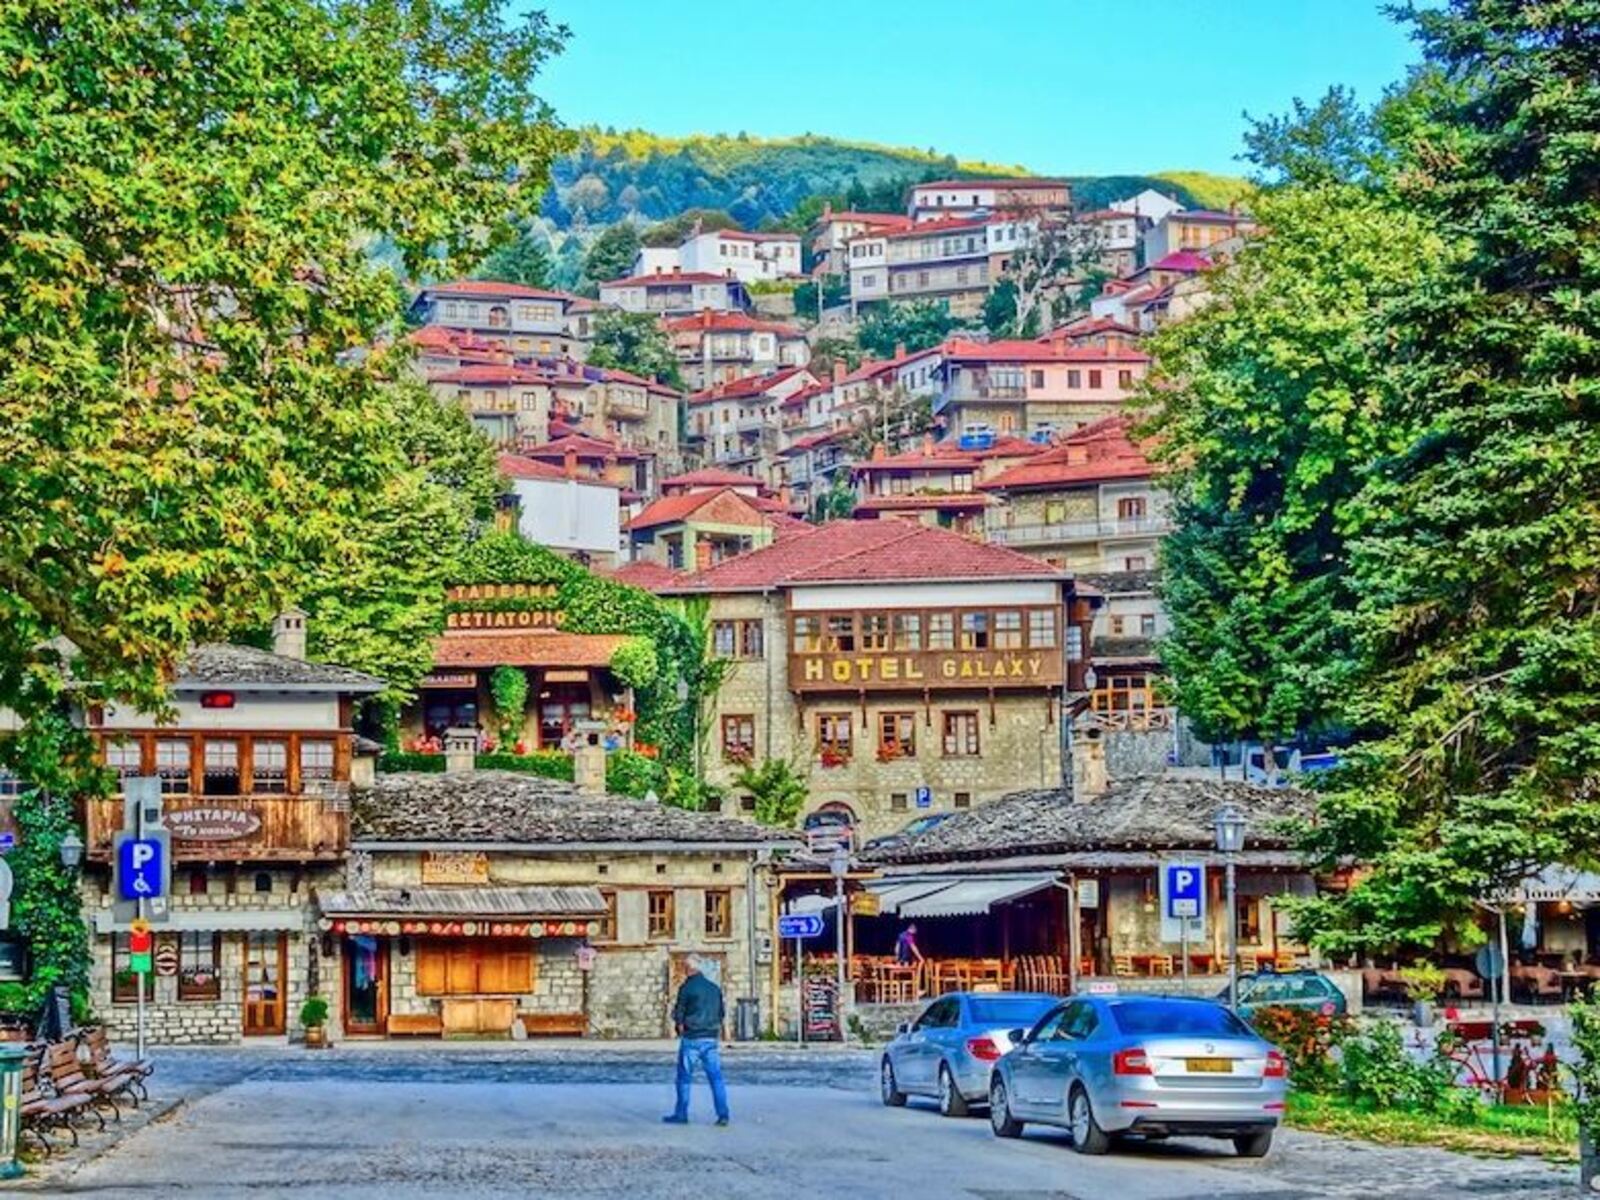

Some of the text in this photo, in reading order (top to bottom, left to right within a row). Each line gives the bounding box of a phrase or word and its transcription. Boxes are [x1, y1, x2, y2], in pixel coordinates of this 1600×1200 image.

[447, 611, 566, 627] ΕΣΤΙΑΤΟΡΙΟ
[805, 658, 1042, 682] HOTEL GALAXY
[169, 809, 247, 823] ΨΗΣΤΑΡΙΑ
[132, 843, 154, 869] P
[1176, 869, 1194, 894] P
